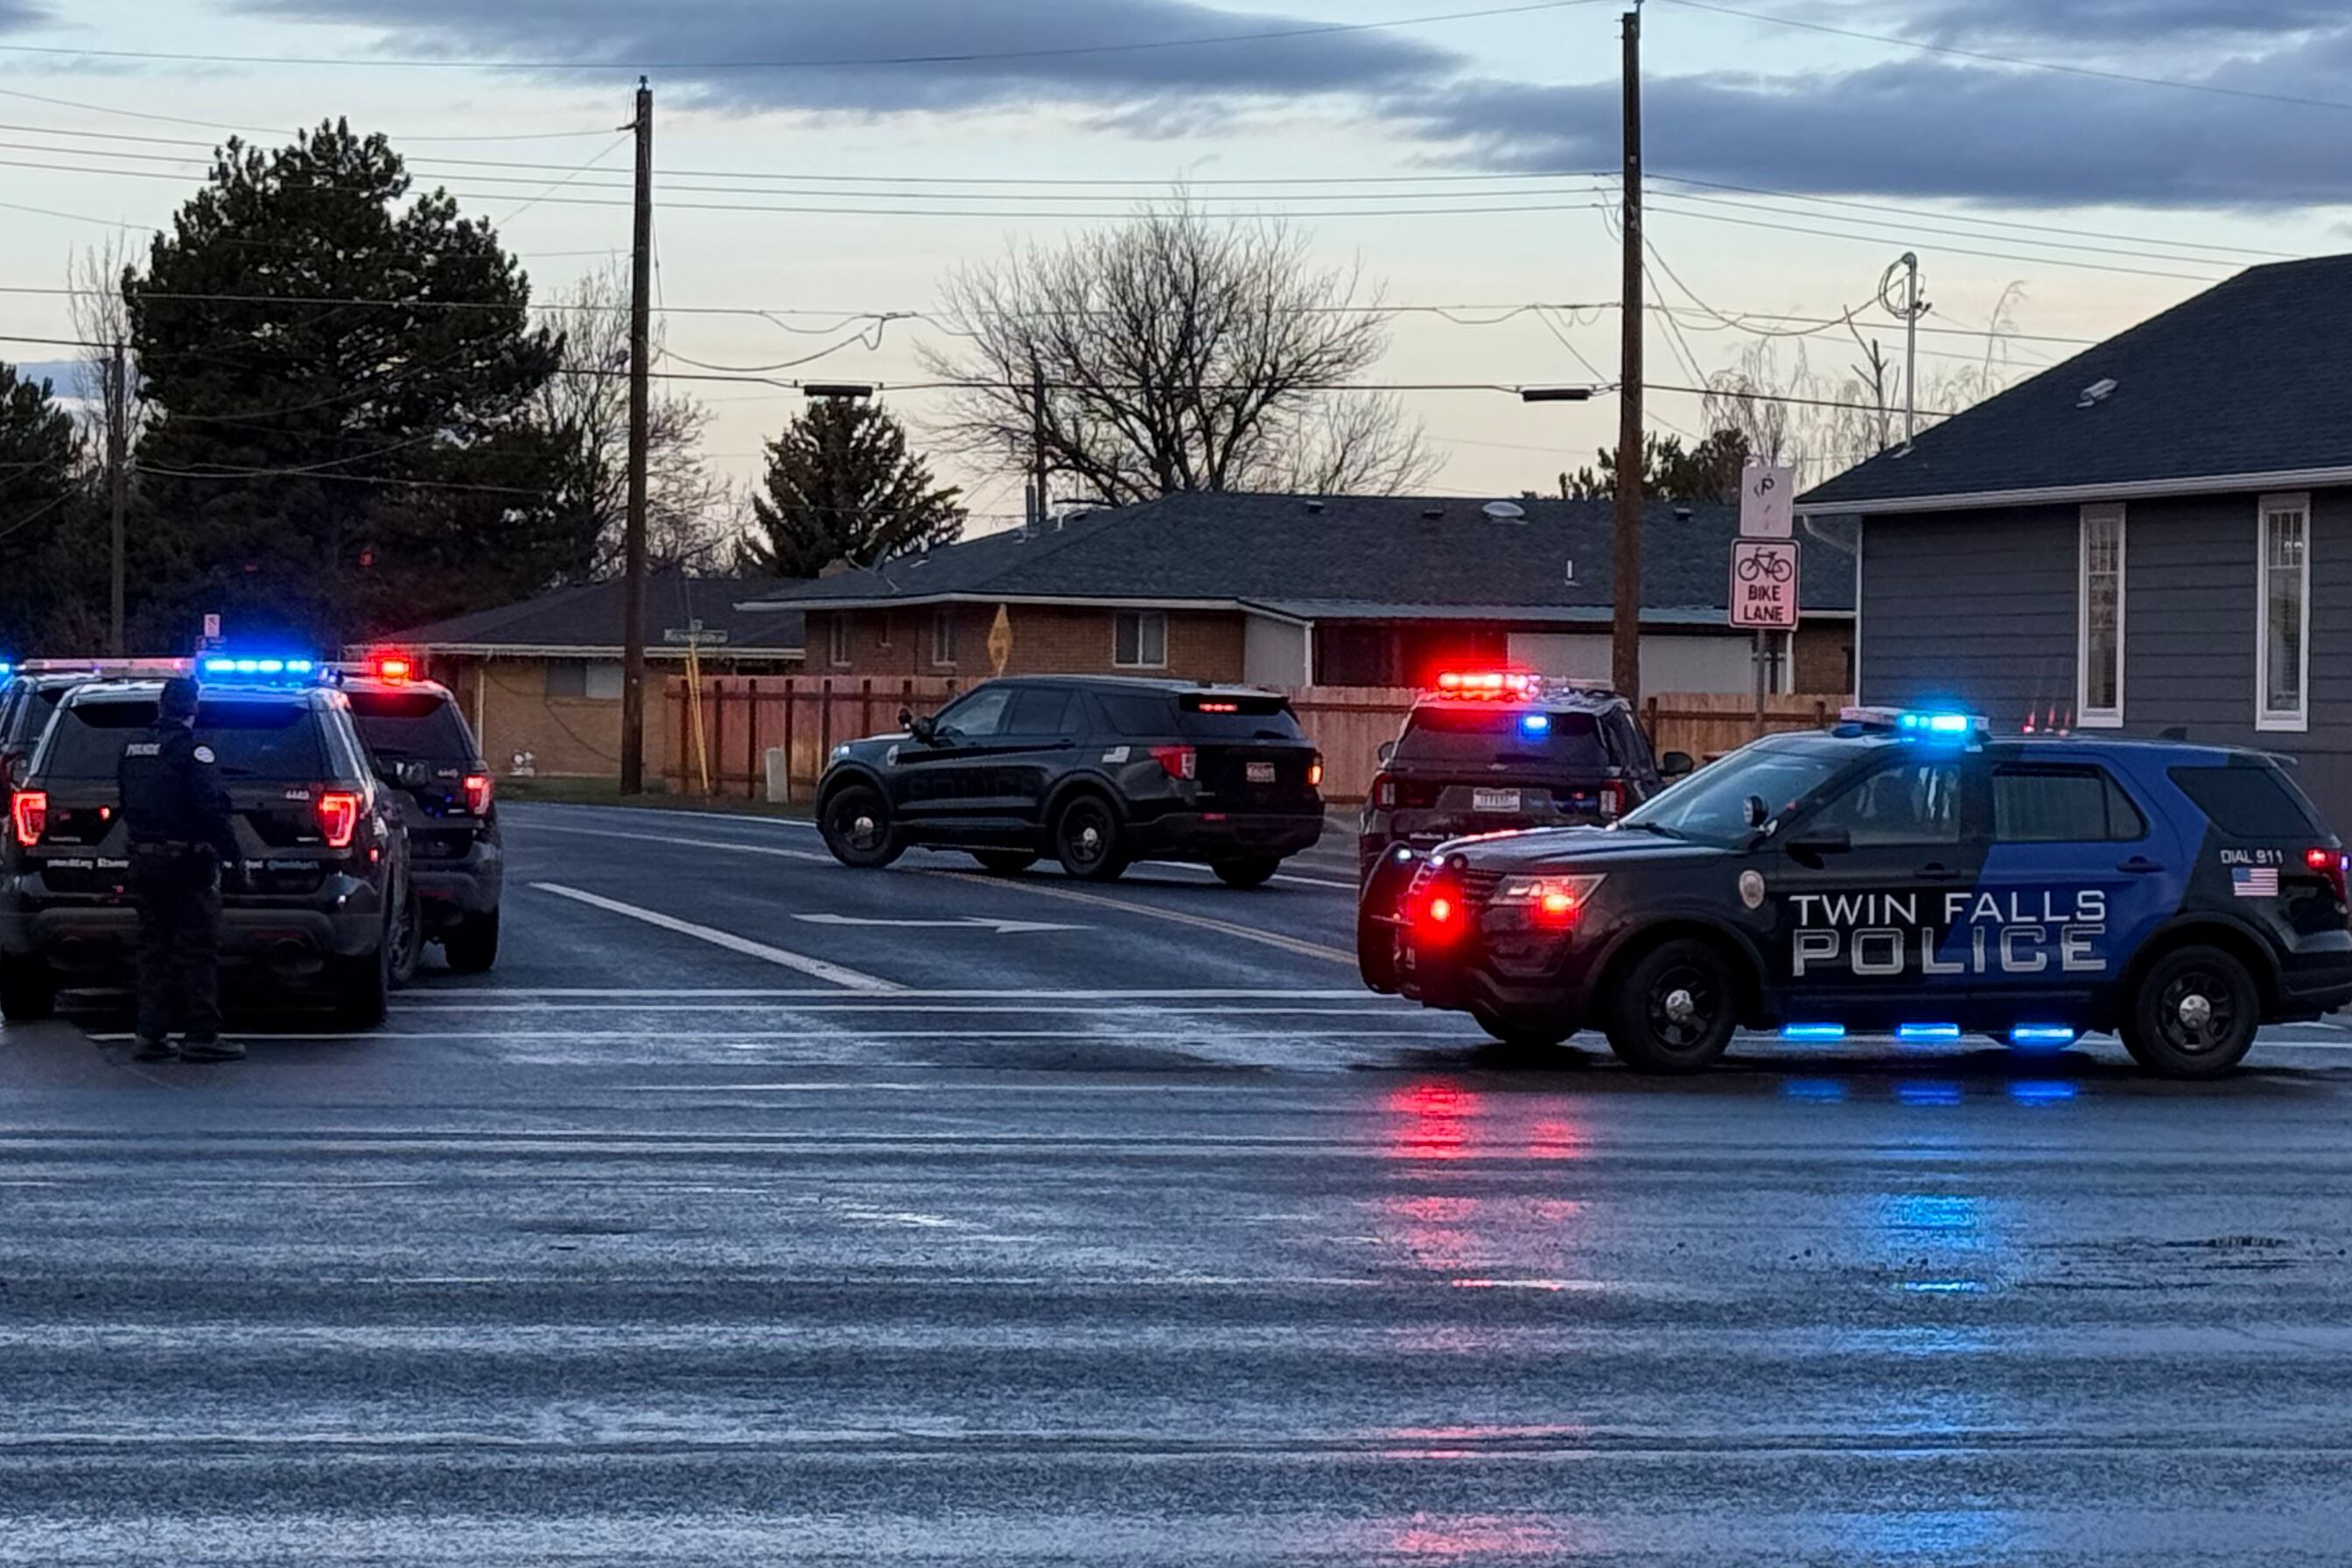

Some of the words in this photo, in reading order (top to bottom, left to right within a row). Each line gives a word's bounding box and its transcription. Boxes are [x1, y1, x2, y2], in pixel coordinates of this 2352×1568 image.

[1747, 584, 1781, 602] BIKE
[1743, 604, 1784, 622] LANE
[2220, 849, 2254, 864] DIAL
[2256, 849, 2284, 864] 911
[1788, 893, 1916, 927] TWIN
[1944, 890, 2107, 925] FALLS
[1792, 923, 2108, 977] POLICE
